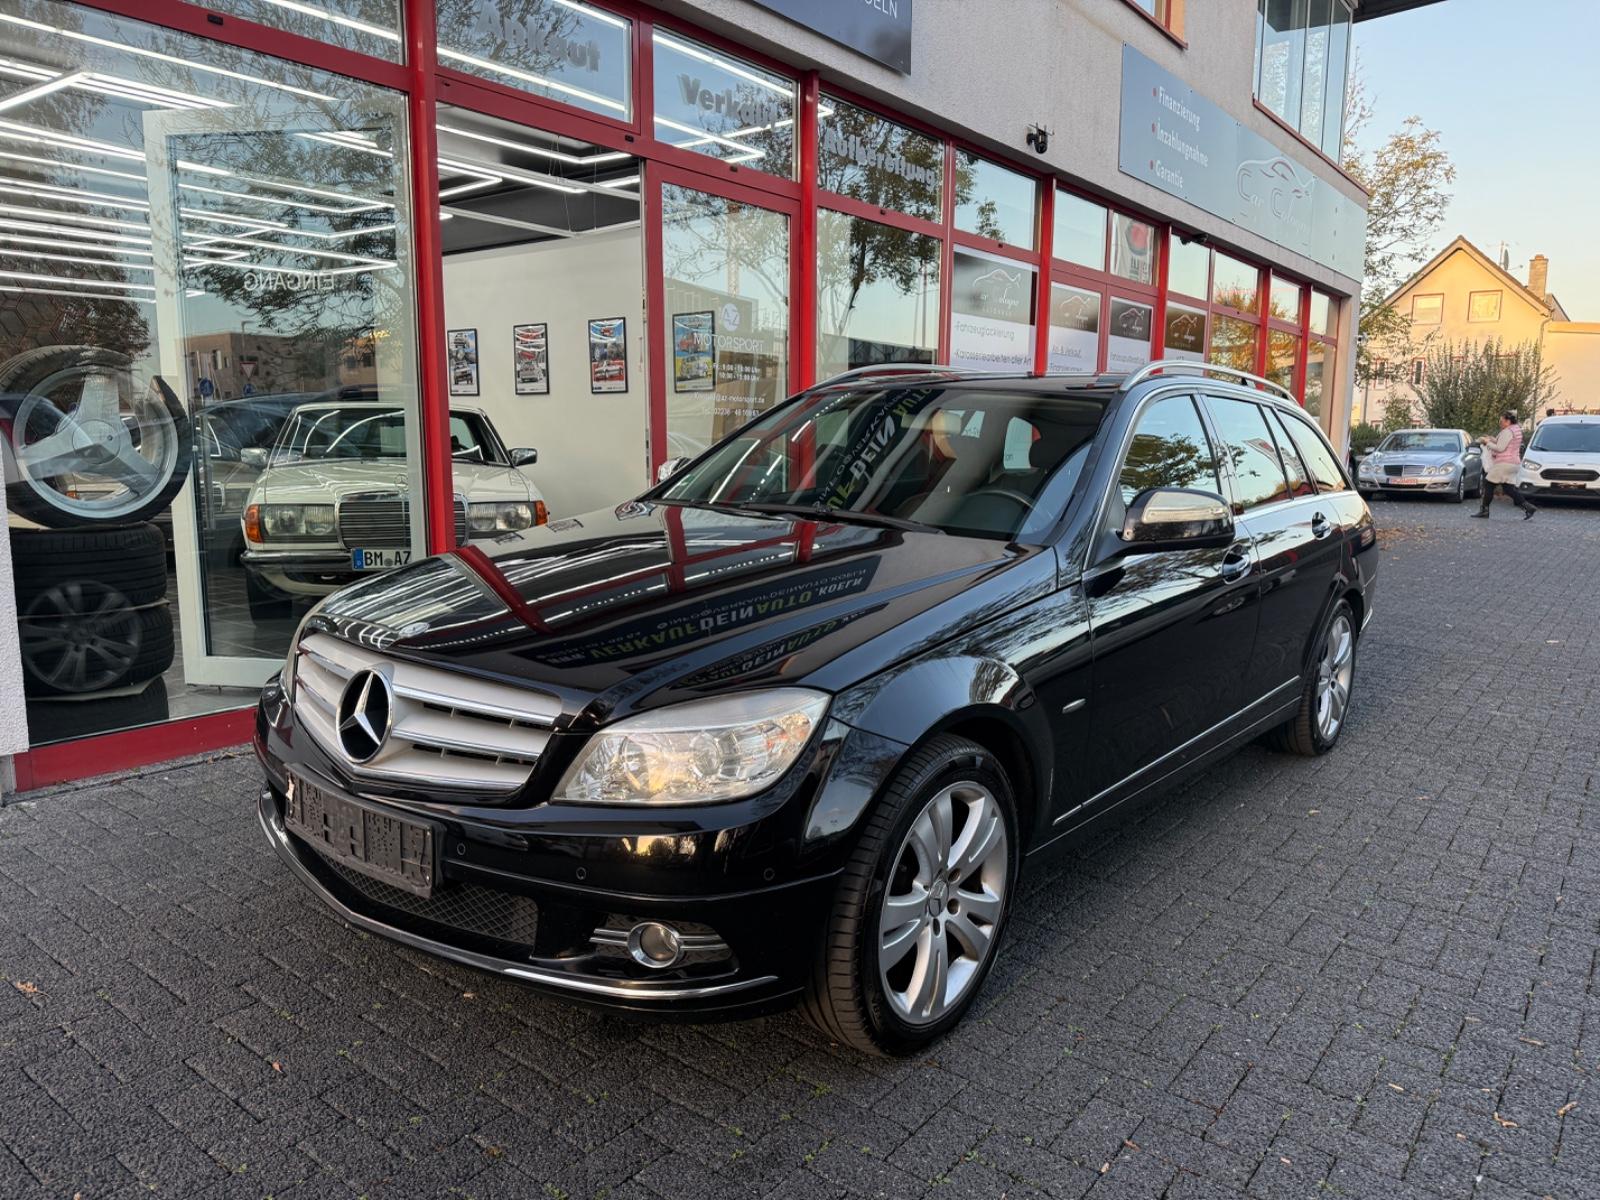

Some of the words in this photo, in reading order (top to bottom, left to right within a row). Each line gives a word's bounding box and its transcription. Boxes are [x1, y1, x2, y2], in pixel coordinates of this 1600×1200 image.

[864, 0, 898, 19] ELN
[474, 0, 599, 73] Ankauf
[677, 73, 776, 128] Verkauf
[1159, 86, 1200, 132] Finanzierung
[822, 127, 938, 193] Aufbereitung
[1156, 160, 1183, 189] Garantie
[693, 333, 765, 353] MOTORSPORT
[364, 551, 383, 566] BM
